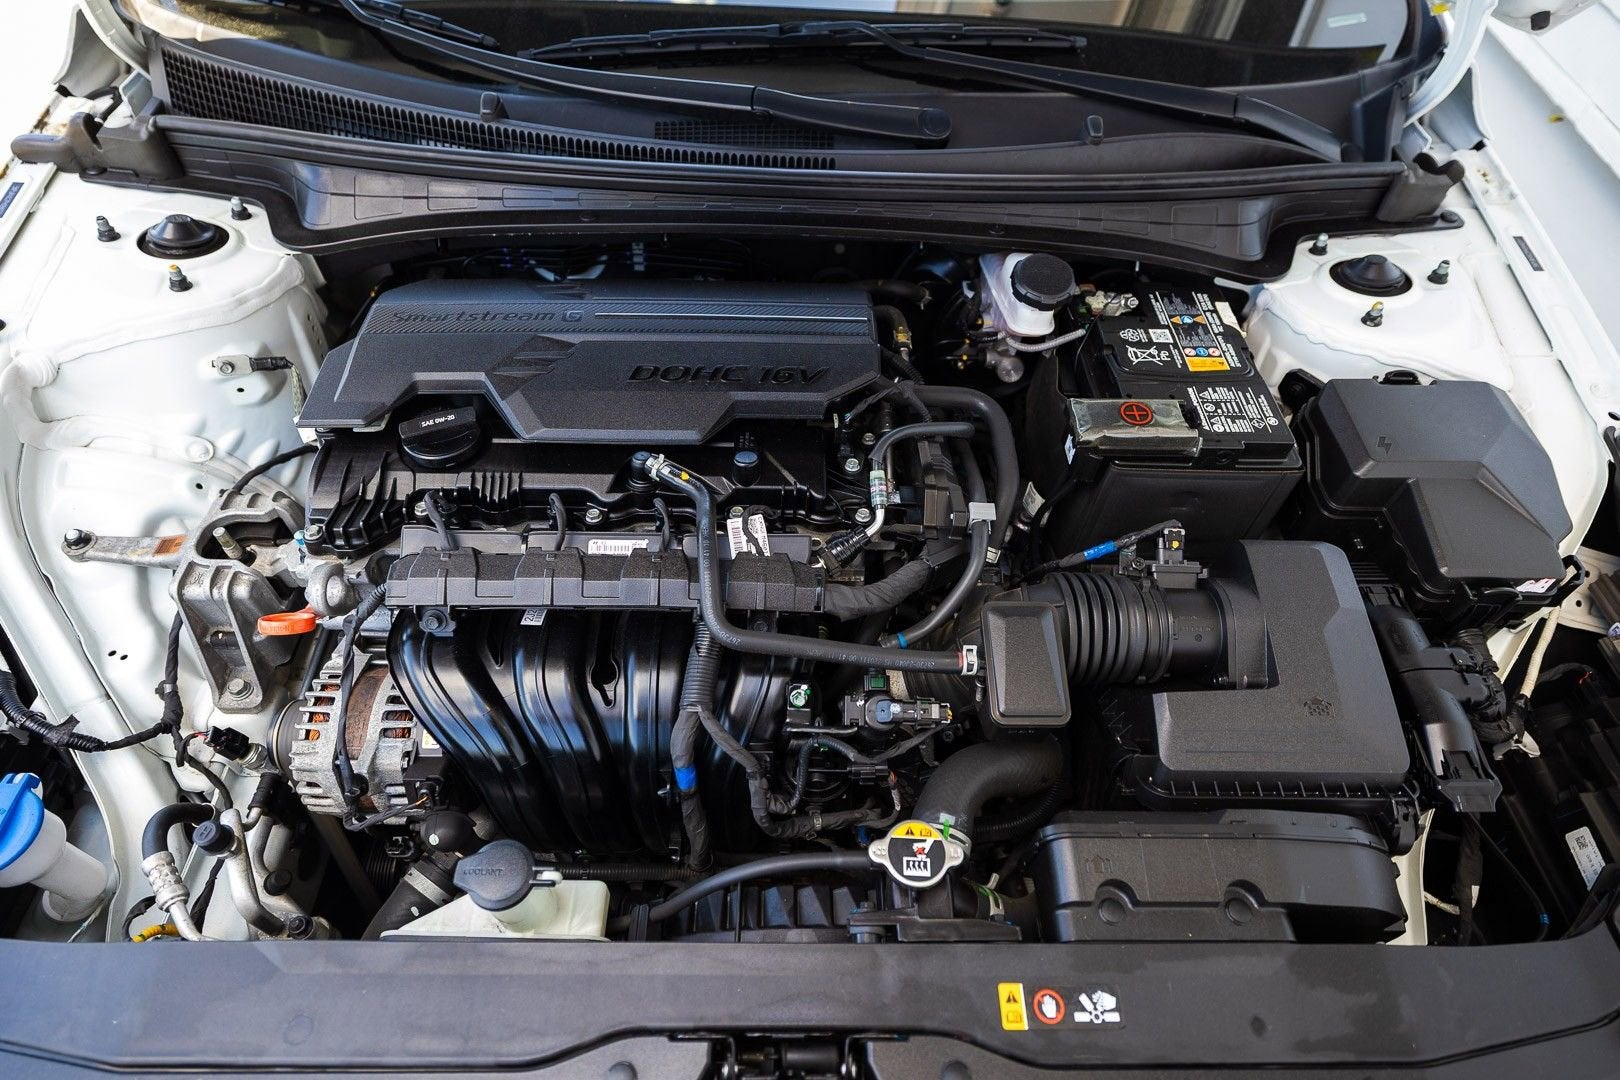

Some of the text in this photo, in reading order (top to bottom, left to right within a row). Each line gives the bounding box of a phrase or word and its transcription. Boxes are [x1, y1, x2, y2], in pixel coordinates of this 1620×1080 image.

[393, 310, 555, 323] Smartstream
[627, 364, 830, 385] DOHC 16V
[421, 414, 456, 428] SAE 0W-20
[463, 868, 503, 877] COOLANT
